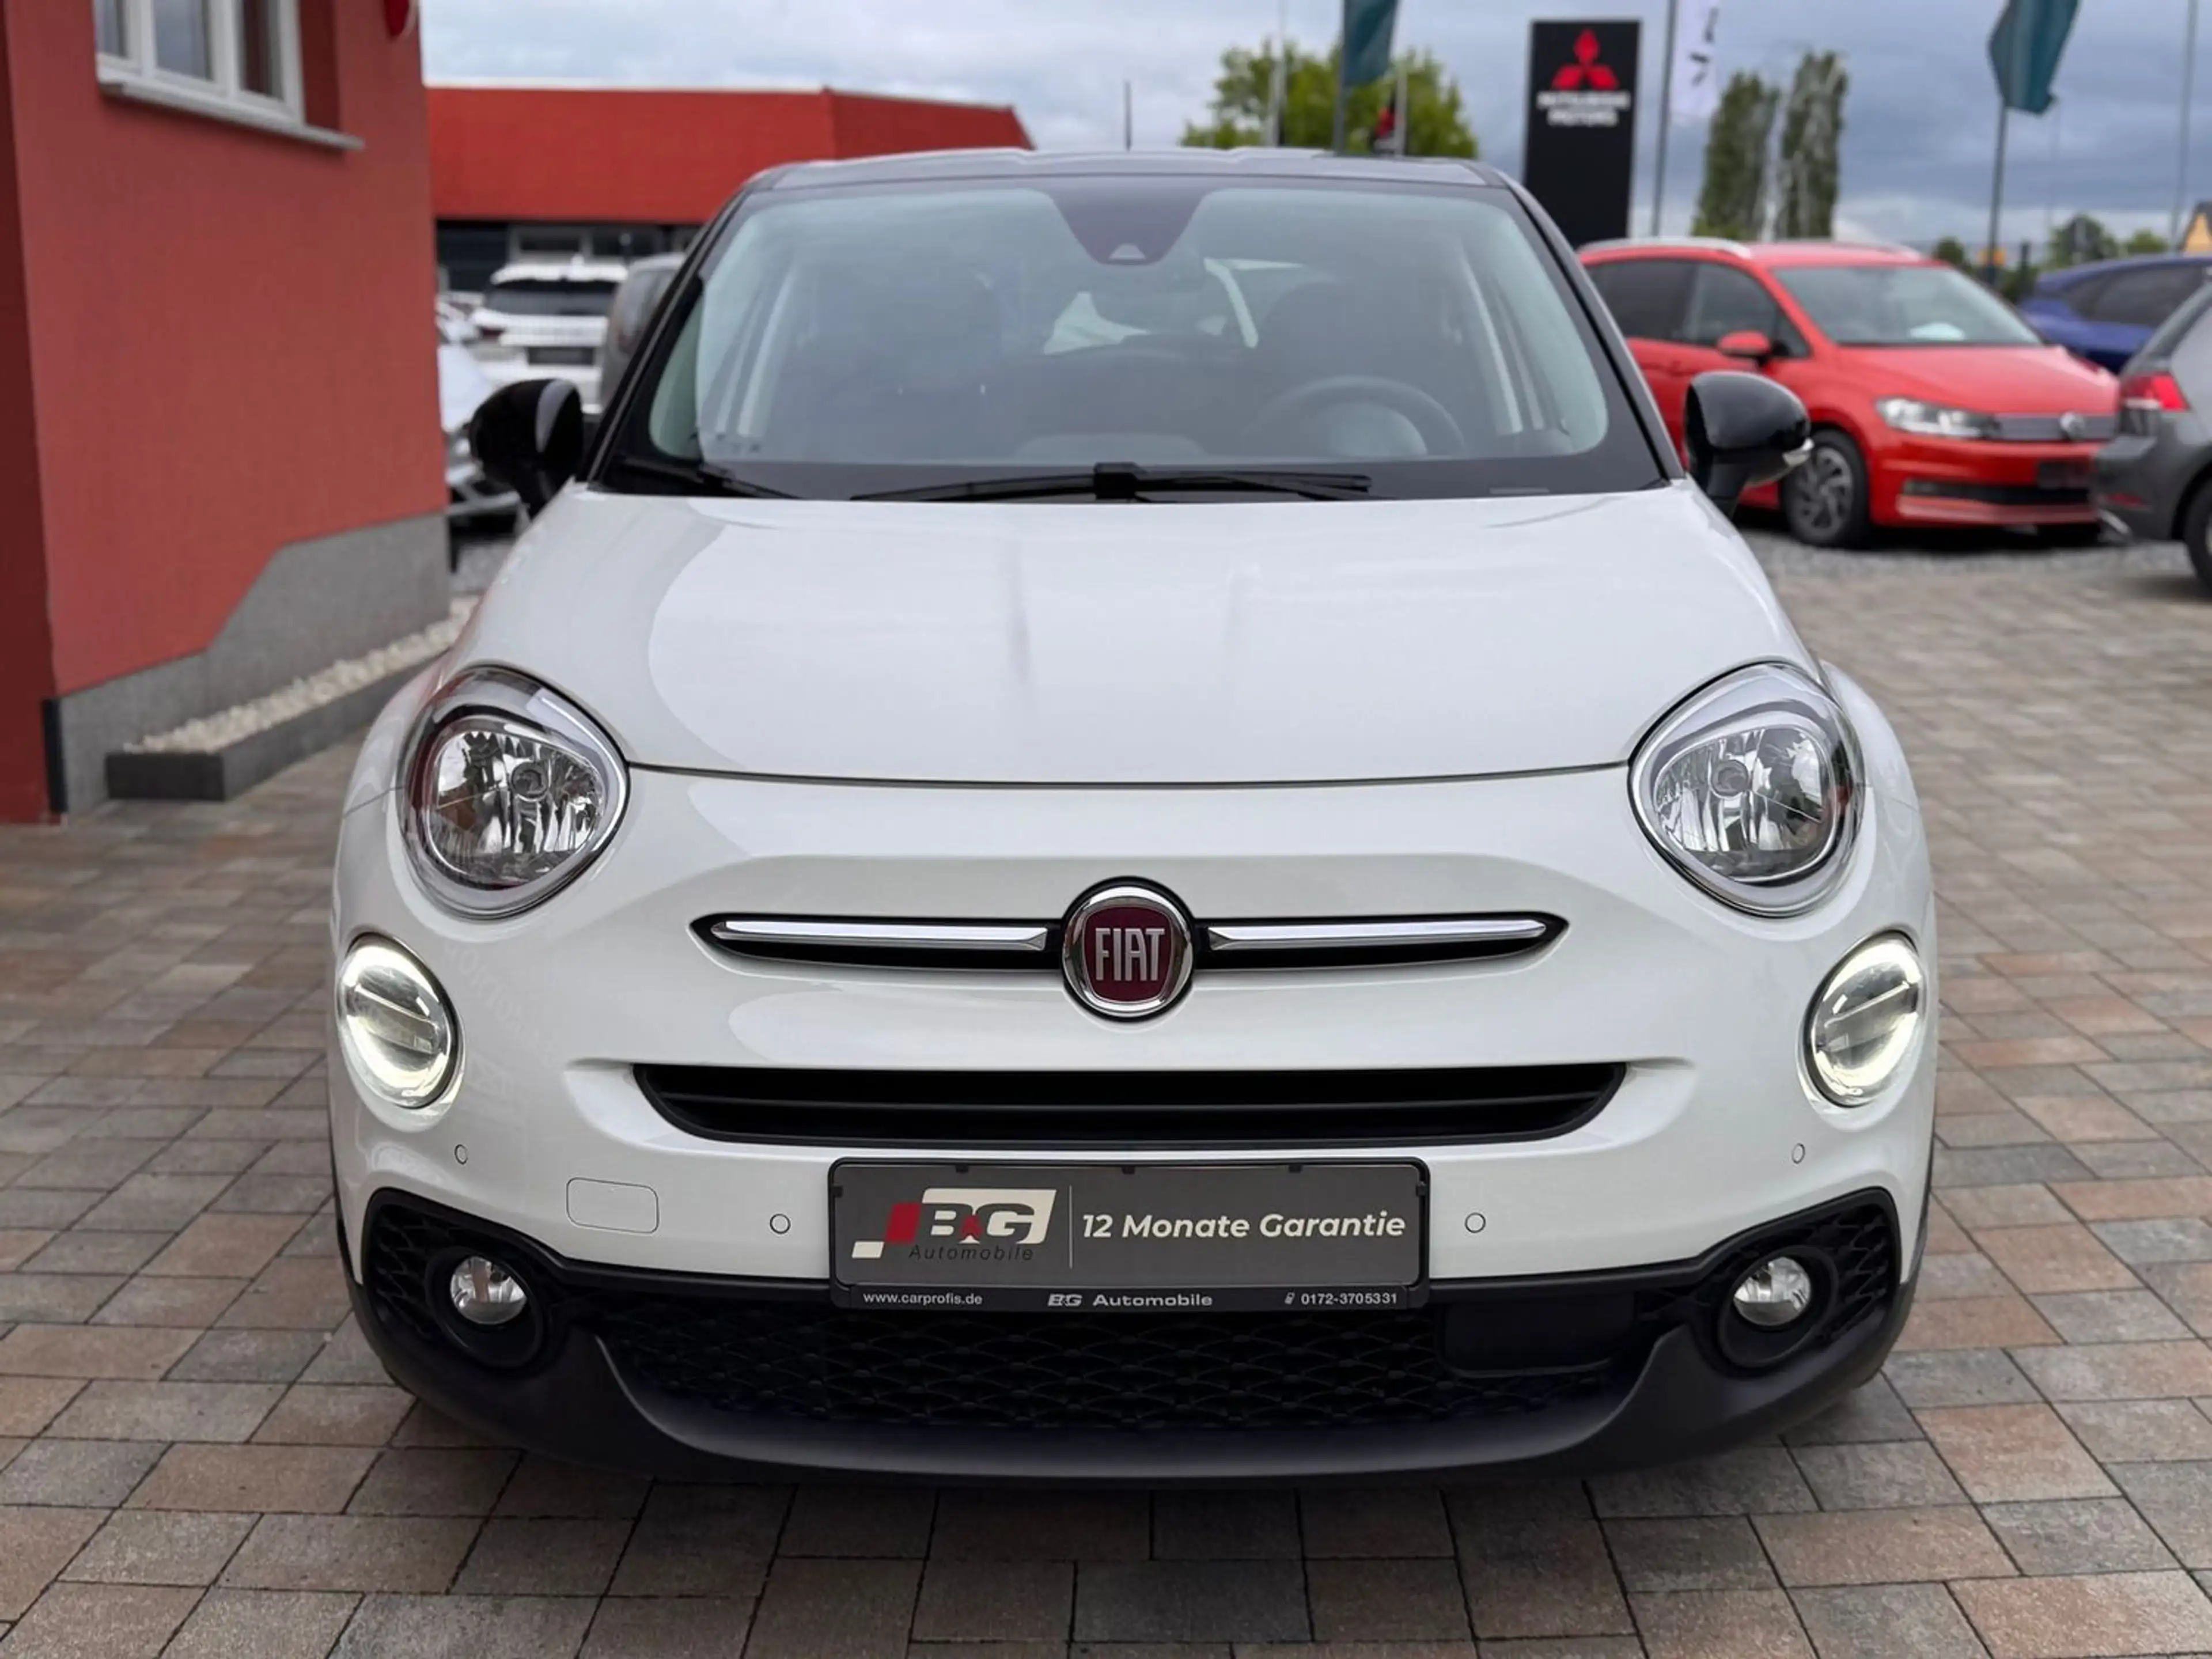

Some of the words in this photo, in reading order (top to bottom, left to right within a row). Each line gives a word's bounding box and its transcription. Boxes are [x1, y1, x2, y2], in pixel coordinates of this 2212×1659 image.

[1095, 927, 1165, 981] FIAT
[1082, 1214, 1112, 1238] 12
[1122, 1214, 1250, 1238] Monate
[1259, 1210, 1406, 1237] Garantie
[908, 1244, 1035, 1261] Automobile
[863, 1293, 983, 1306] www.carprofis.de
[1092, 1293, 1213, 1306] Automobile
[1300, 1293, 1398, 1305] 0172-3705331
